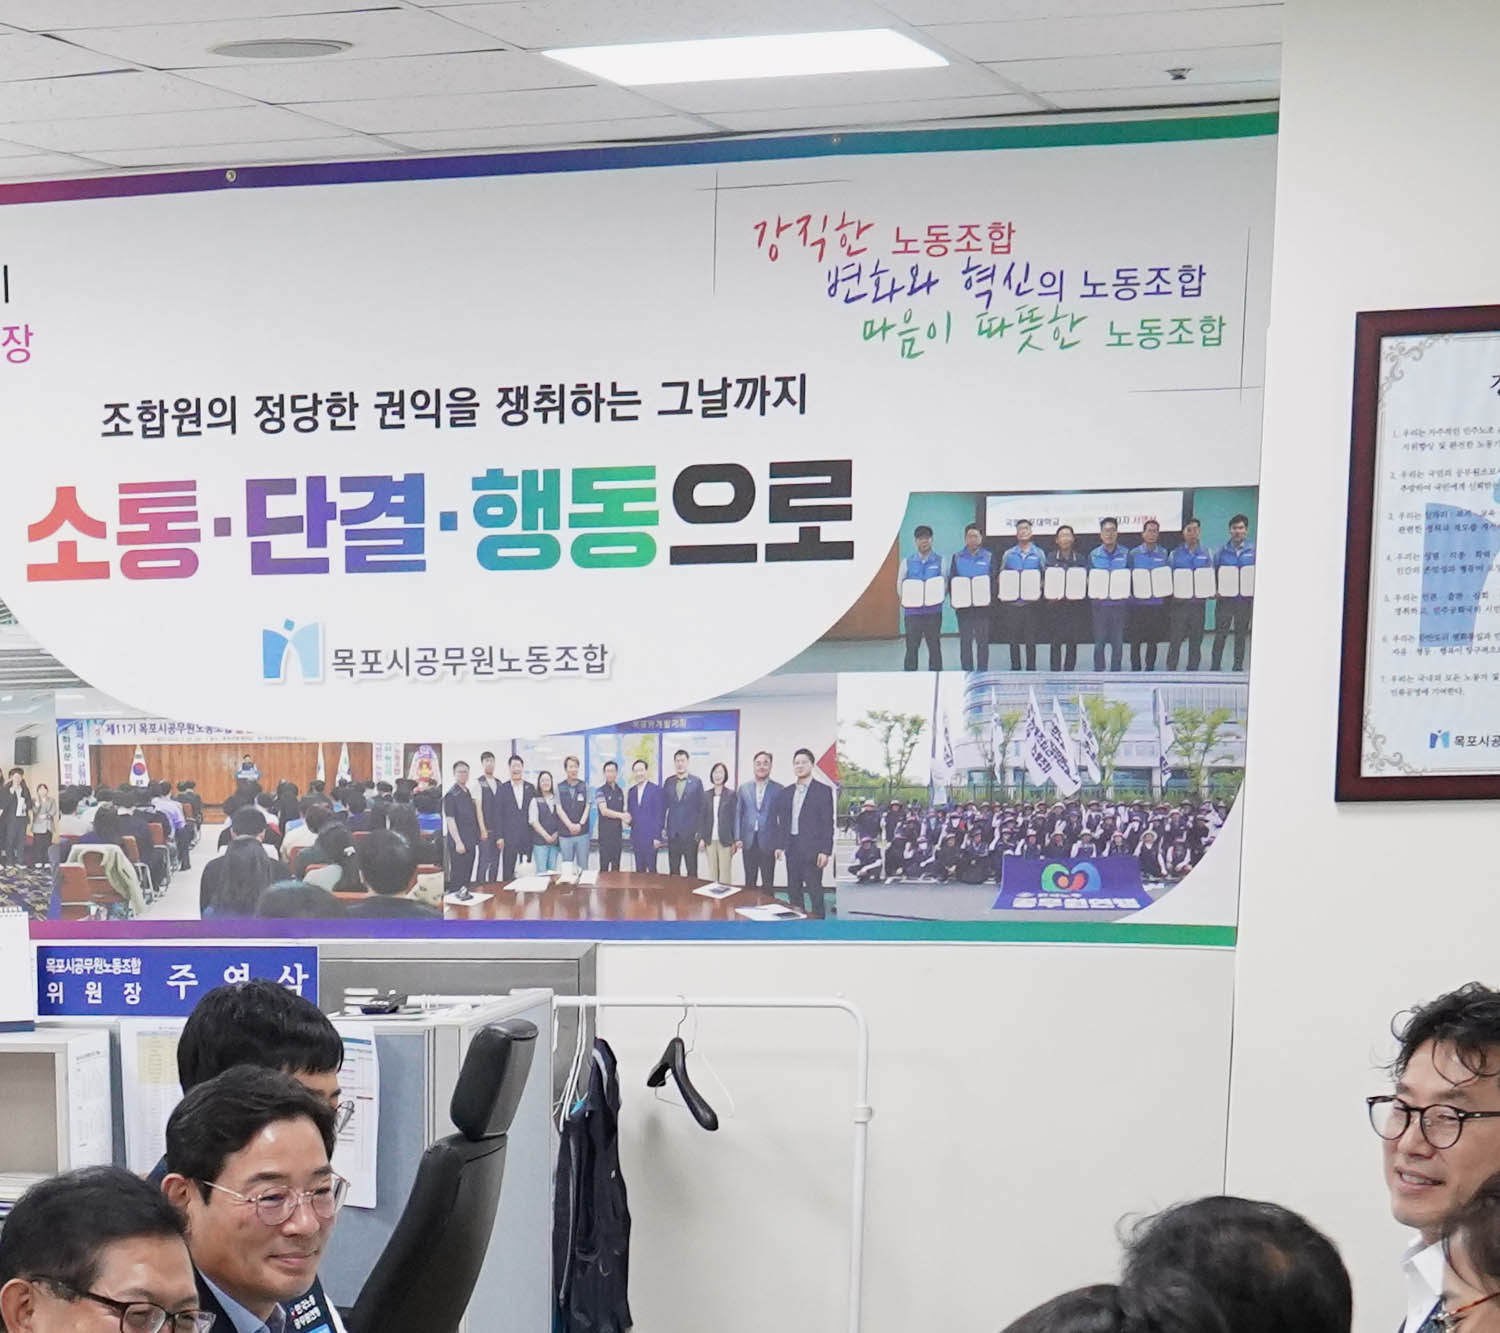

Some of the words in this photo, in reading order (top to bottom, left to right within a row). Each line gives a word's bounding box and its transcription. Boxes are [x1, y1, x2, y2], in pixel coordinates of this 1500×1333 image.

[753, 211, 875, 264] 강직한
[892, 222, 1017, 260] 노동조합
[825, 255, 941, 306] 변화와
[960, 256, 1065, 310] 혁신의
[1078, 264, 1208, 304] 노동조합
[861, 307, 952, 361] 마음이
[976, 302, 1090, 355] 따뜻한
[1105, 314, 1227, 351] 노동조합
[101, 394, 239, 440] 조합원의
[252, 391, 359, 435] 정당한
[372, 386, 481, 431] 권익을
[494, 381, 644, 428] 쟁취하는
[656, 373, 808, 418] 그날까지
[331, 643, 609, 679] 목포시공무원노동조합
[45, 957, 142, 975] 목포시공무원노동조합
